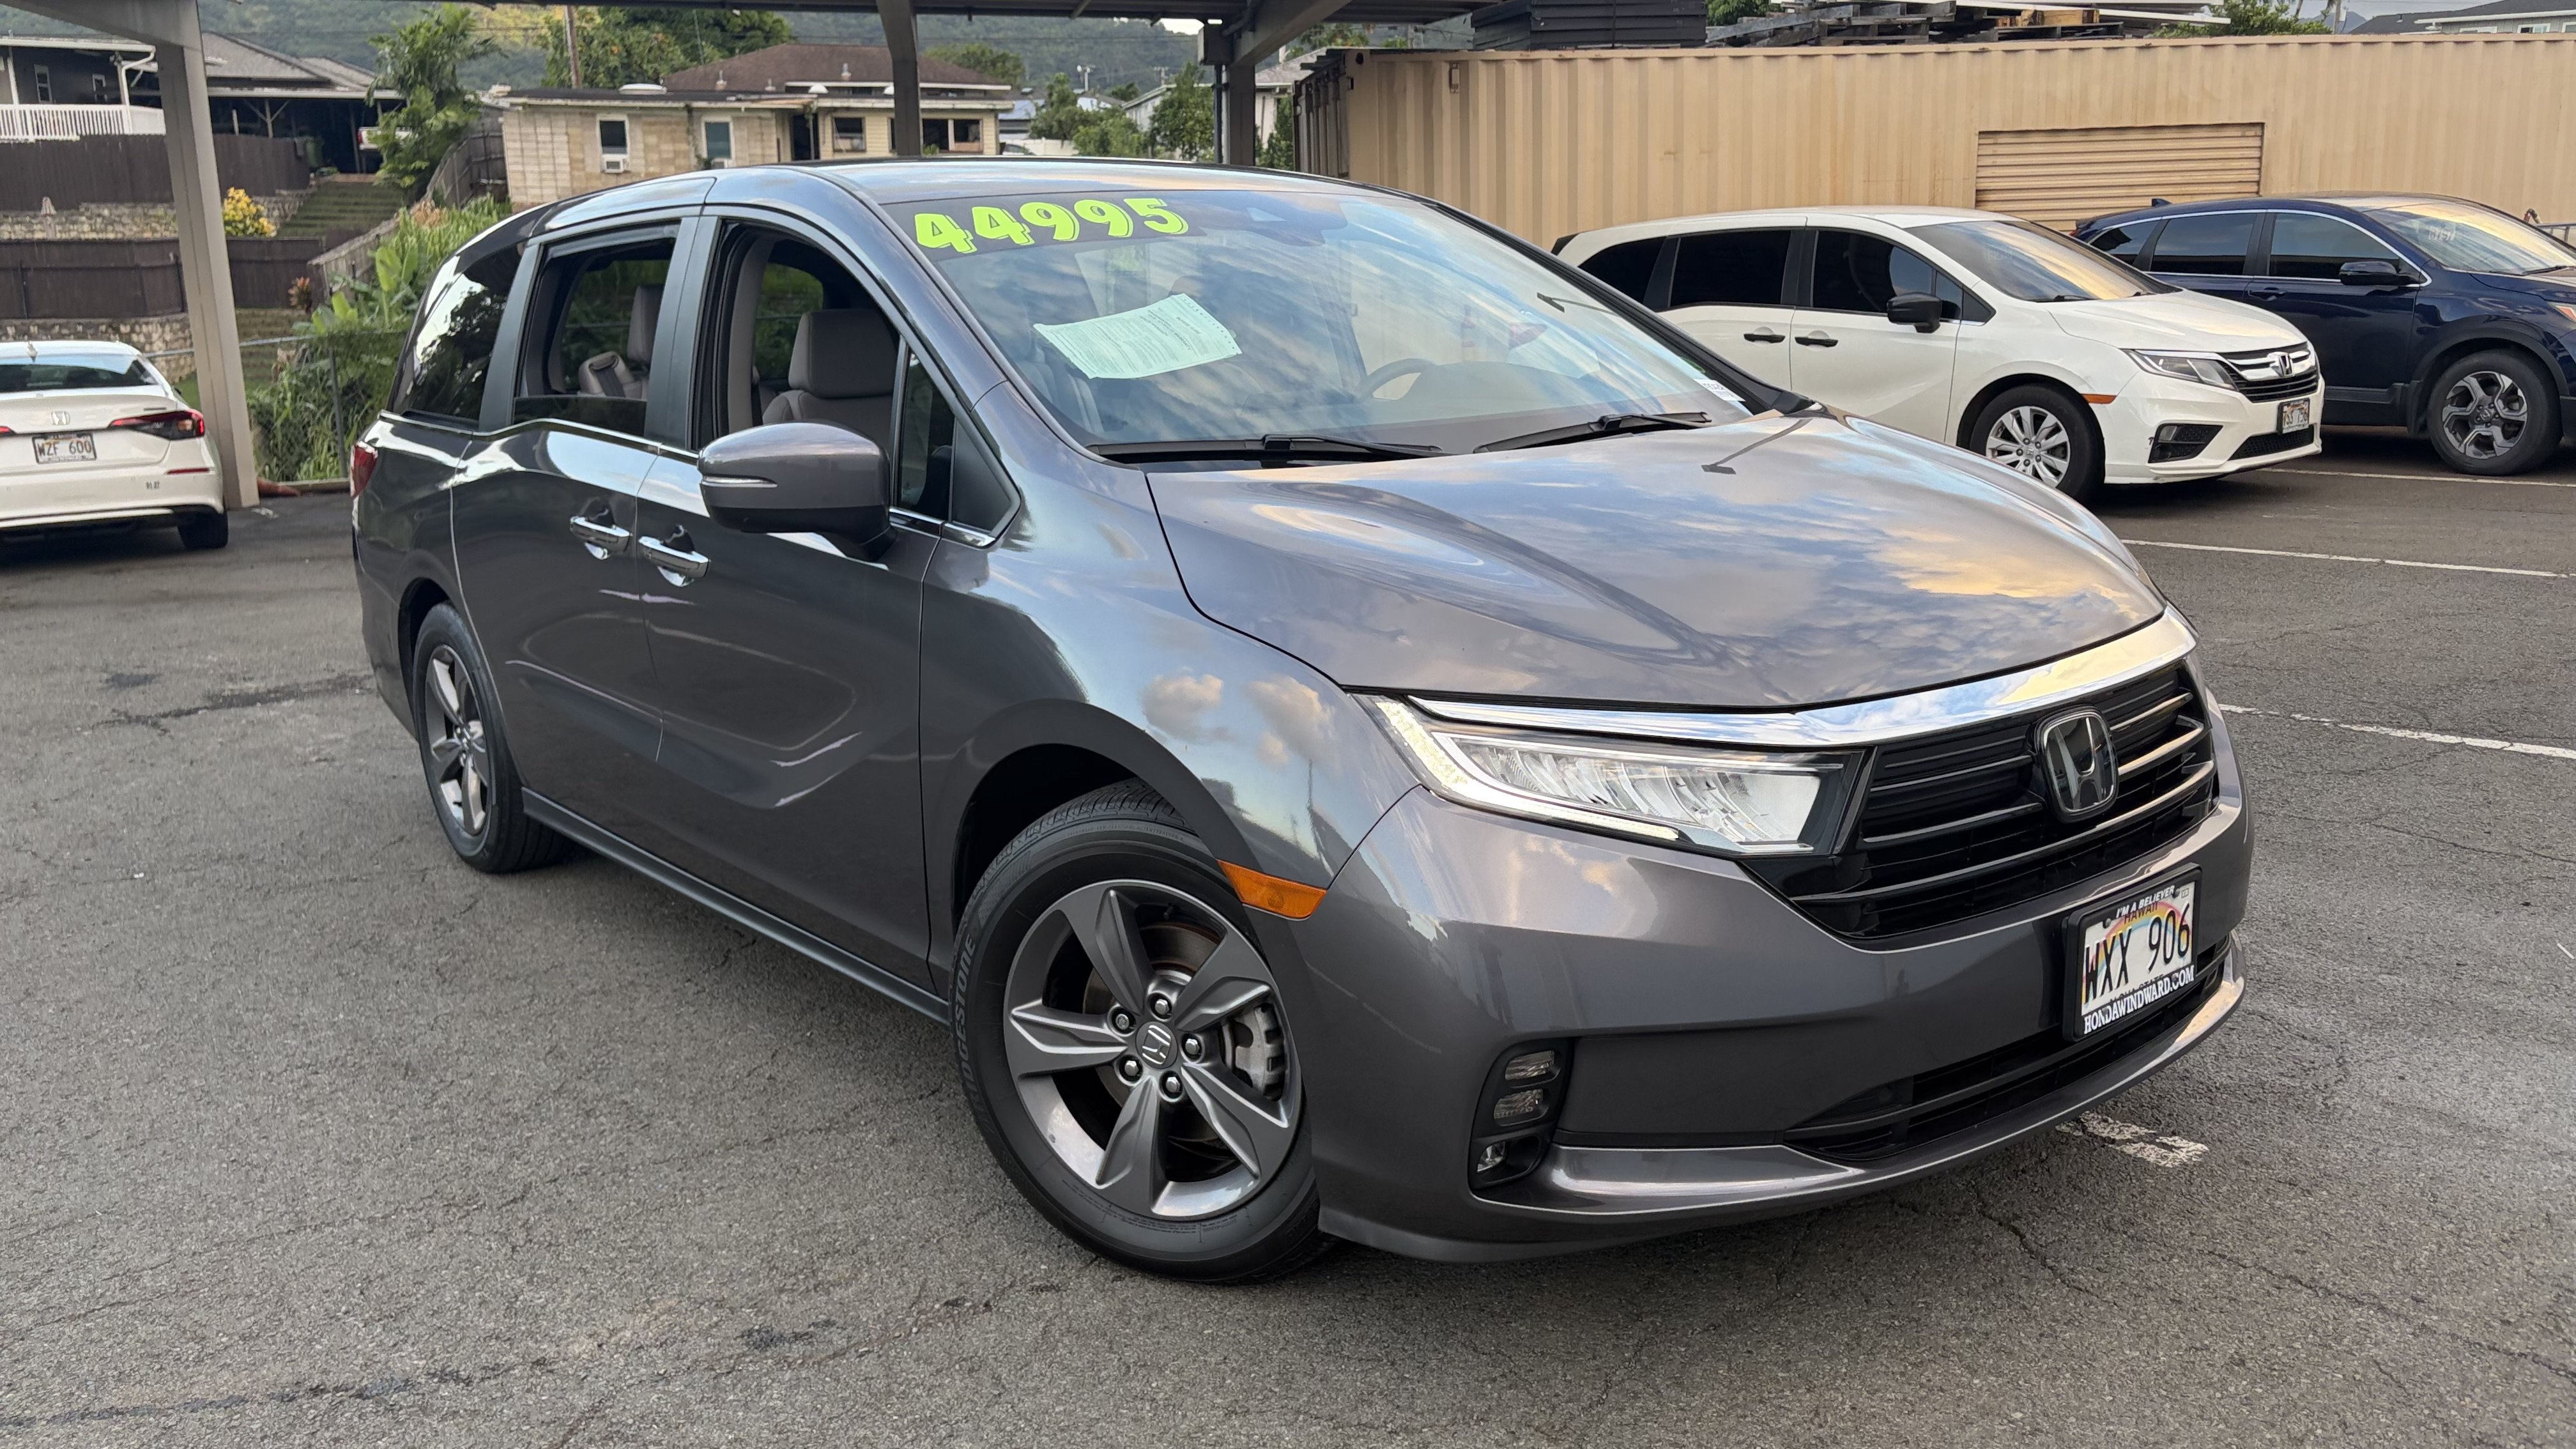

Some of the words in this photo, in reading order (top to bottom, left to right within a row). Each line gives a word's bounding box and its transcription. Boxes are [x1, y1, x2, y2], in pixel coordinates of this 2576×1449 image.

[914, 197, 1190, 254] 44995
[38, 441, 58, 456] WZF
[69, 440, 92, 455] 600
[2116, 904, 2130, 919] I'M
[2130, 901, 2137, 913] A
[2138, 885, 2175, 909] BELIEVER
[2124, 901, 2158, 924] HAWAII
[2085, 926, 2132, 1004] WXX
[2148, 902, 2189, 972] 906
[2083, 965, 2195, 1035] HONDAWINDWARD.COM
